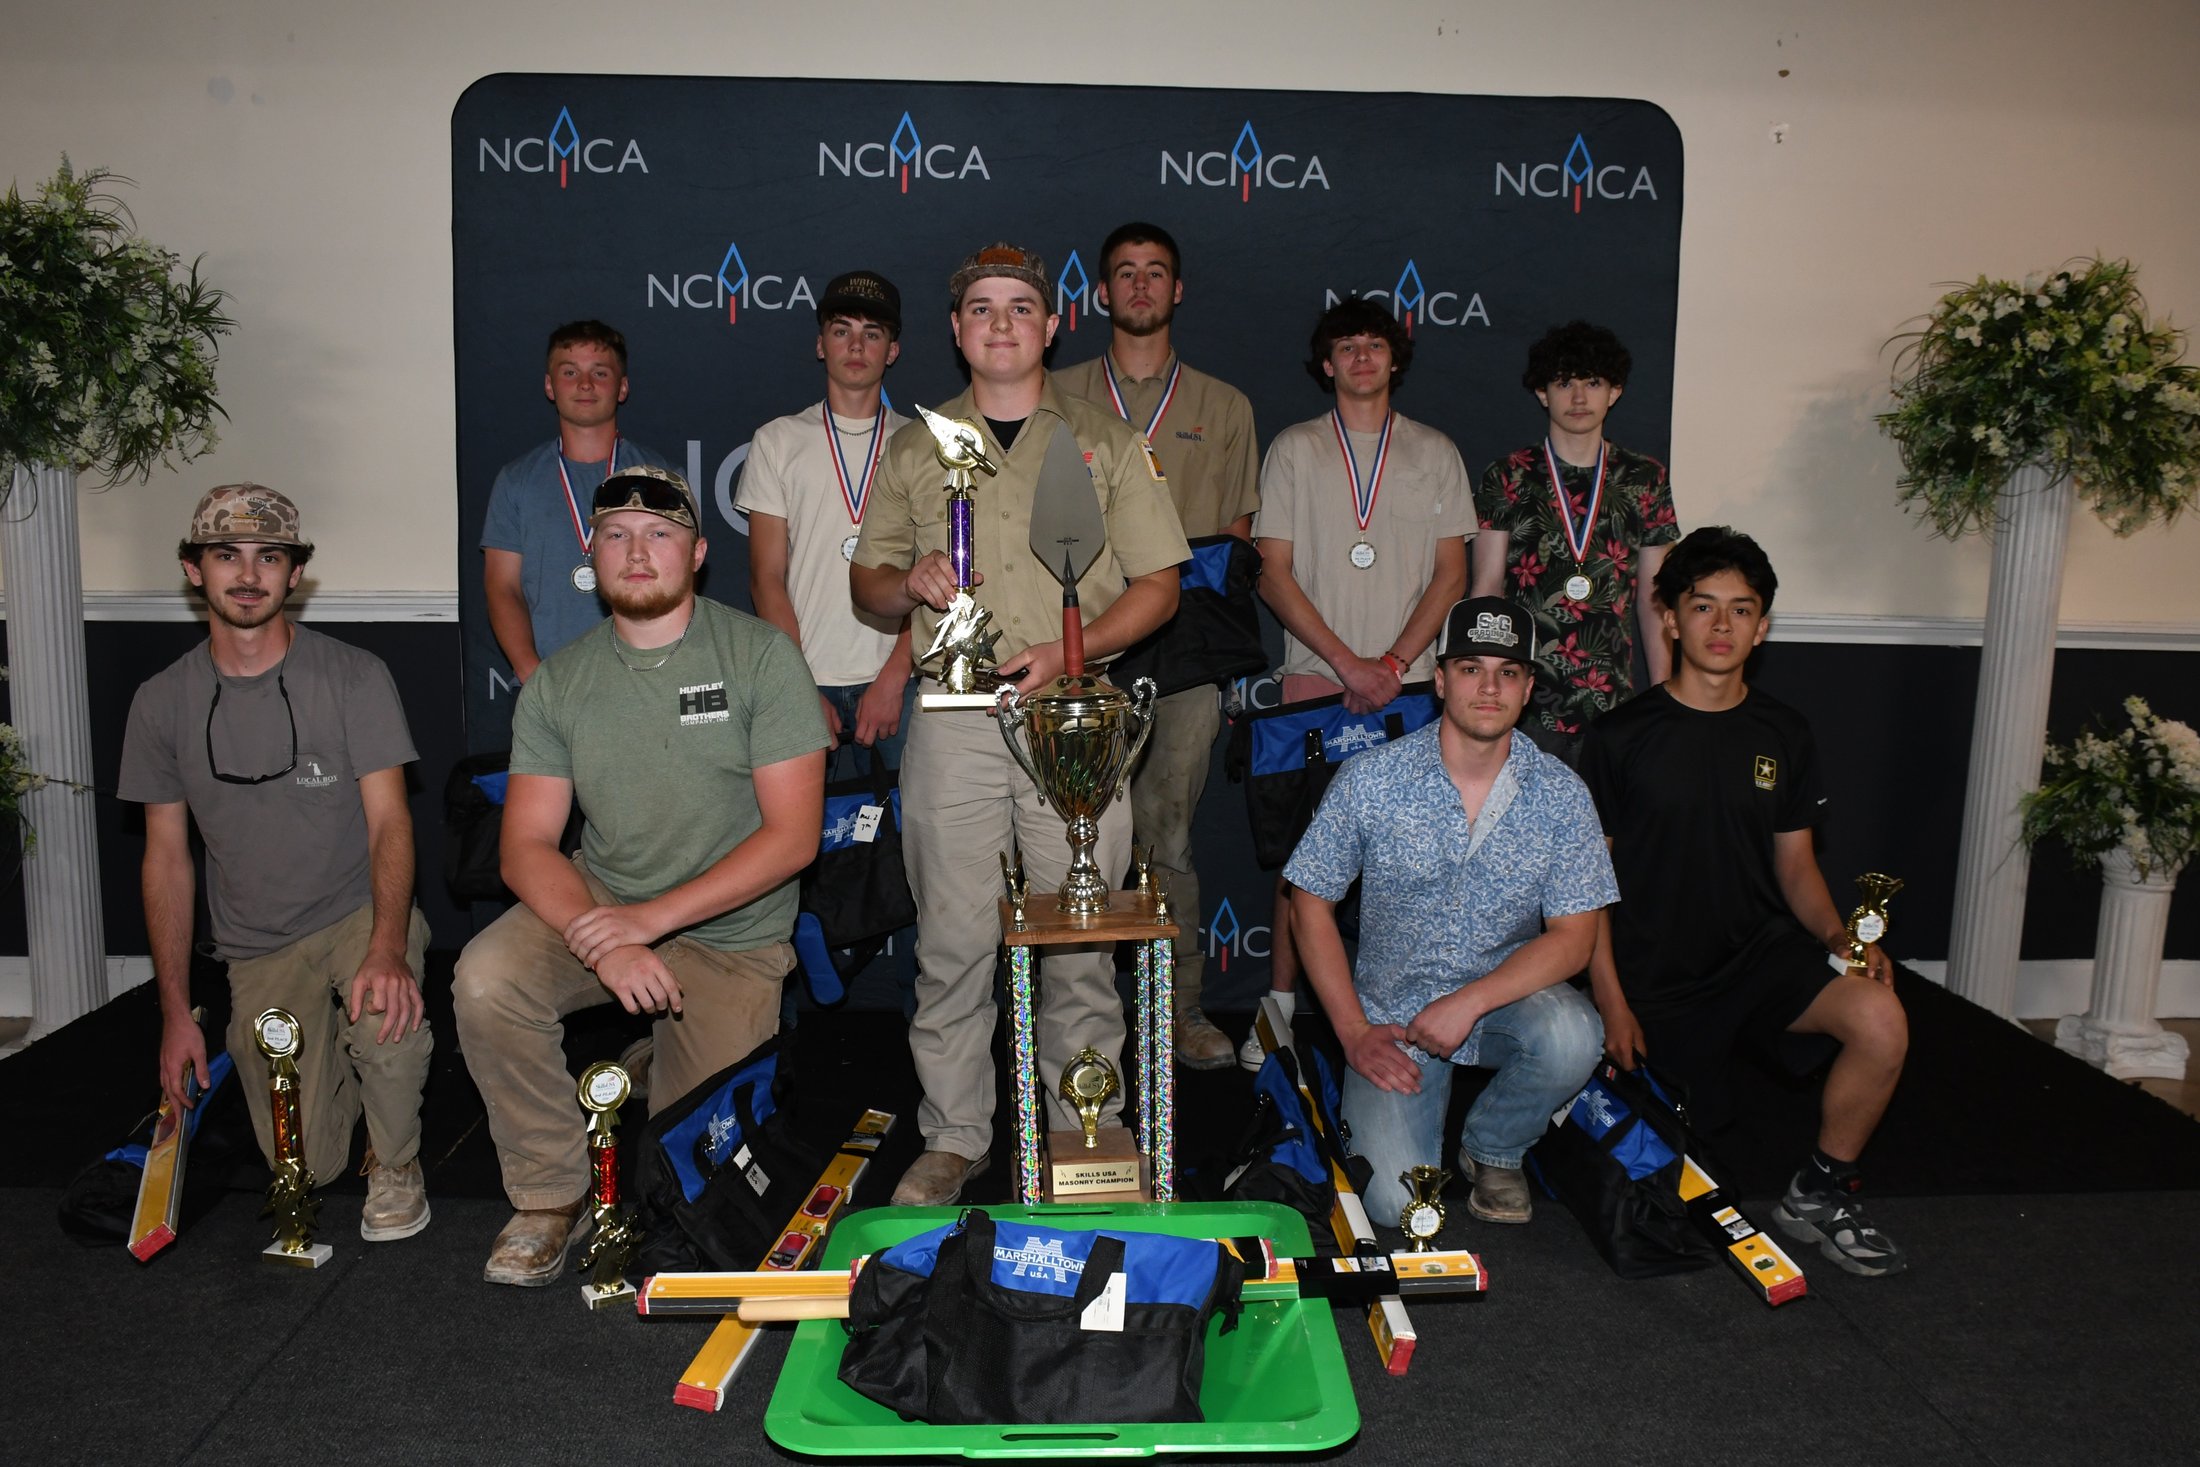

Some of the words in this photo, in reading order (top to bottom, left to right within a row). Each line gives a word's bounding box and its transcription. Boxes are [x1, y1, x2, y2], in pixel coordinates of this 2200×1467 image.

[479, 137, 649, 174] NCMCA
[819, 142, 991, 181] NCMCA
[1161, 150, 1331, 190] NCMCA
[1495, 162, 1658, 201] NCMCA
[647, 273, 818, 311] NCMCA
[1469, 629, 1505, 638] GRADING
[680, 681, 724, 695] HUNTLEY
[680, 688, 729, 715] HB
[680, 710, 730, 722] BROTHERS
[1326, 731, 1385, 746] MARSHALLTOWN
[296, 776, 322, 785] LOCAL
[1095, 1177, 1134, 1185] CHAMPION
[995, 1248, 1085, 1273] MARSHALLTOWN
